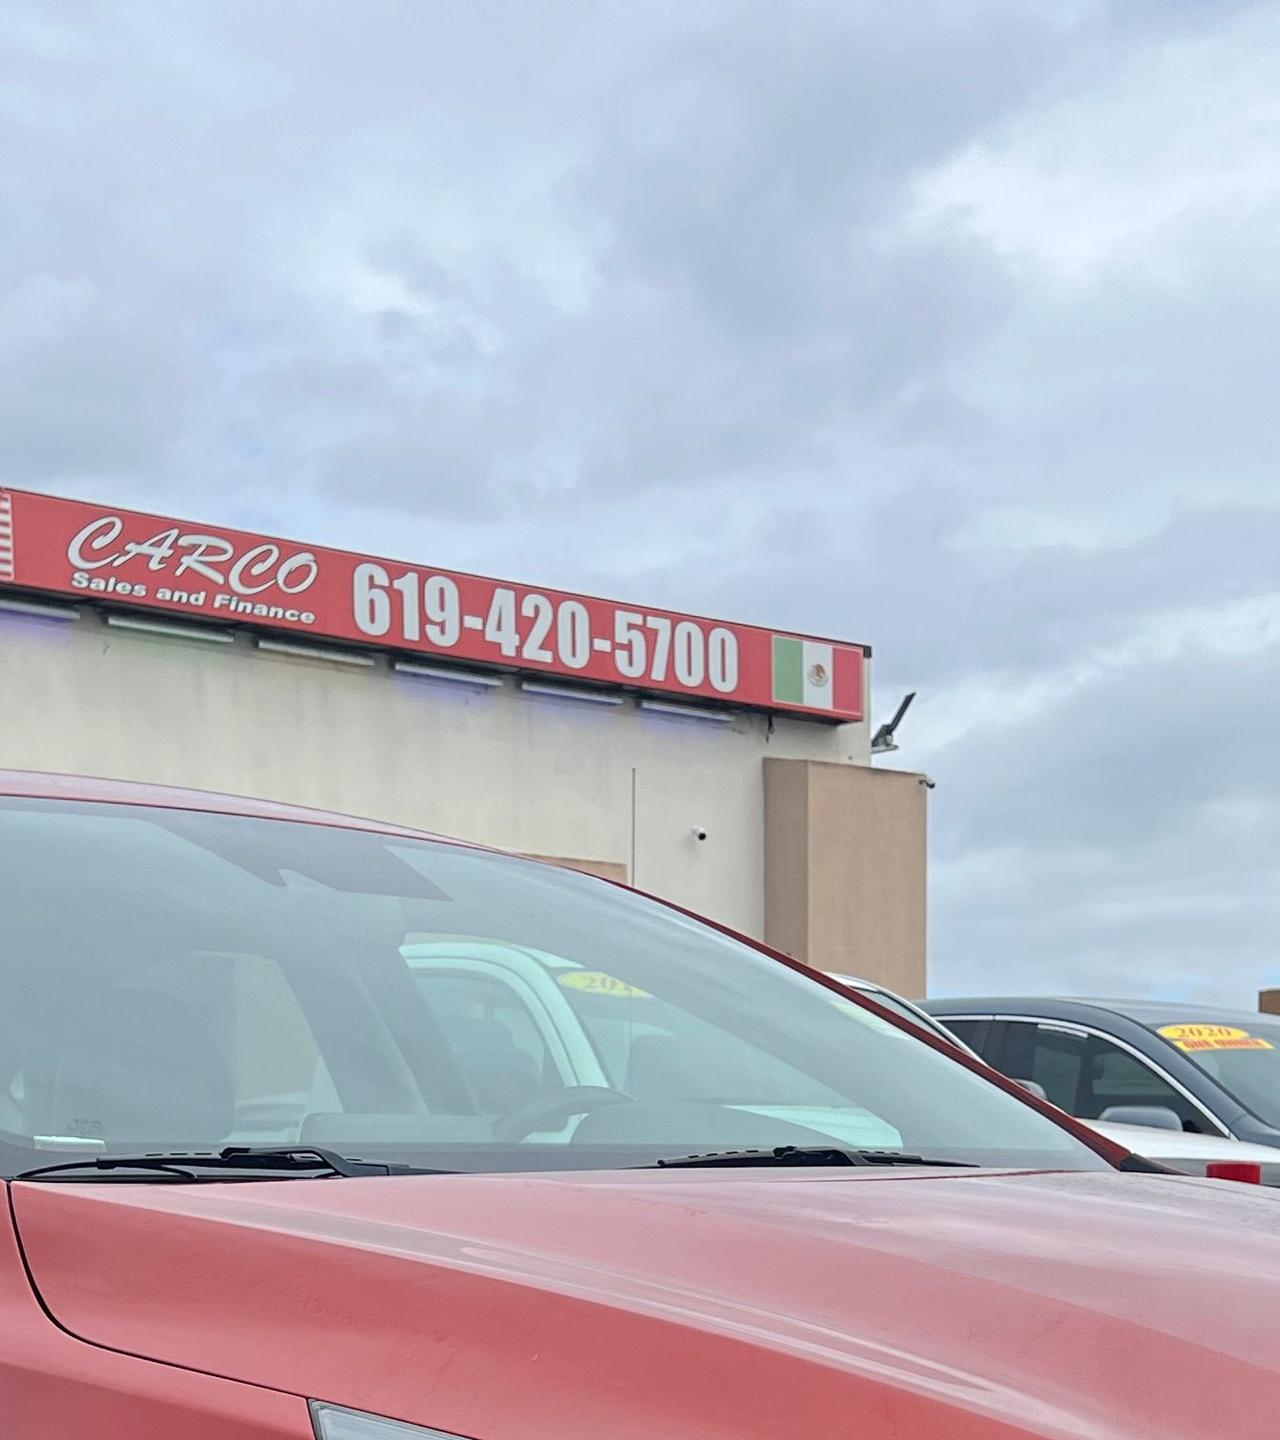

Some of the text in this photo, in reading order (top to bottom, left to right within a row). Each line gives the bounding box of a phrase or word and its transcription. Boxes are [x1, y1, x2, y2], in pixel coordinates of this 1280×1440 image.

[67, 515, 318, 596] CARCO
[71, 570, 317, 624] Sales and Finance
[351, 562, 739, 694] 619-420-5700
[1174, 1027, 1233, 1038] 2020
